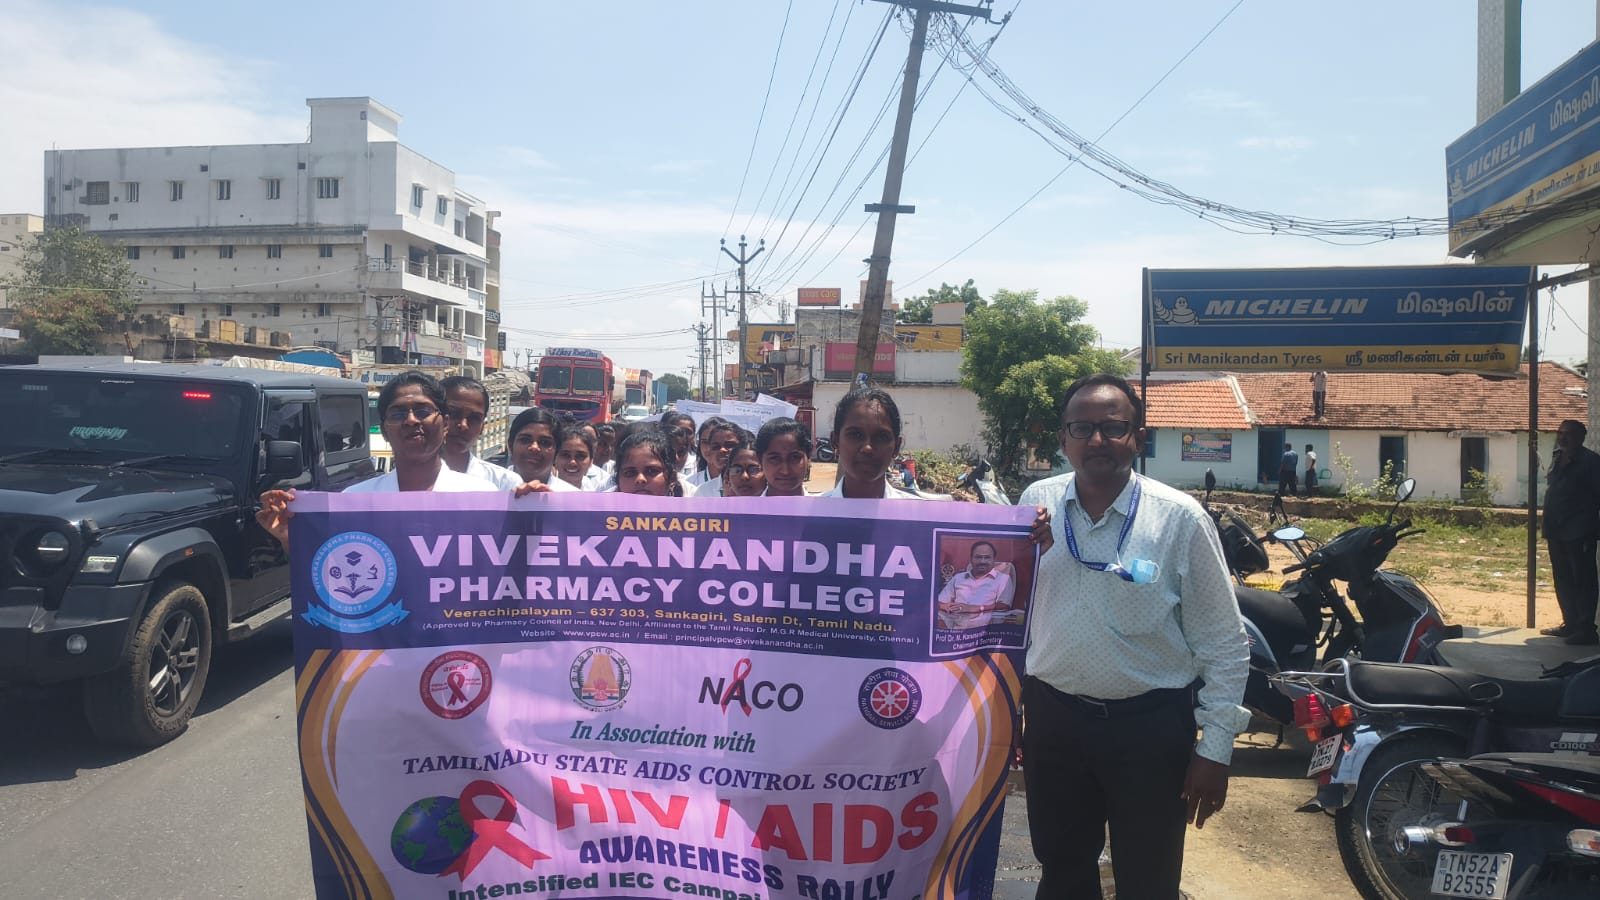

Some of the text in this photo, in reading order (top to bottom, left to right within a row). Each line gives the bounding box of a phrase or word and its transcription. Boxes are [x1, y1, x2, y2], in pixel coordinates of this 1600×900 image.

[1550, 75, 1600, 131] மிஷலி
[1466, 123, 1536, 182] MICHELIN
[1204, 298, 1369, 315] MICHELIN
[1396, 289, 1516, 317] மிஷலின்
[1165, 352, 1322, 367] Sri Manikandan Tyres
[1345, 350, 1363, 367] ஸ்ரீ
[1367, 350, 1461, 363] மணிகண்டன்
[605, 516, 729, 532] SANKAGIRI
[408, 534, 924, 580] VIVEKANANDHA
[429, 576, 905, 616] PHARMACY COLLEGE
[422, 622, 469, 630] (Approved
[471, 620, 482, 629] by
[484, 619, 528, 627] Pharmacy
[644, 620, 681, 629] Affiliated
[694, 622, 707, 630] the
[733, 625, 754, 633] Nadu
[797, 629, 829, 638] Medical
[878, 635, 914, 643] Chennai
[443, 607, 572, 619] Veerachipalayam
[590, 608, 615, 617] 637
[620, 608, 649, 619] 303,
[655, 609, 728, 622] Sankagiri,
[733, 613, 777, 625] Salem
[808, 617, 848, 629] Tamil
[853, 620, 897, 632] Nadu.
[520, 630, 556, 638] Website
[644, 632, 668, 640] Email
[698, 675, 804, 713] NACO
[570, 720, 756, 752] In Association with
[403, 749, 926, 792] TAMILNADU STATE AIDS CONTROL SOCIETY
[551, 776, 689, 830] HIV
[751, 791, 939, 864] AIDS
[579, 836, 895, 900] AWARENESS RALLY
[1449, 853, 1498, 875] TN52A
[448, 872, 598, 900] Intensified
[609, 872, 655, 889] IEC
[1443, 873, 1497, 897] B2555
